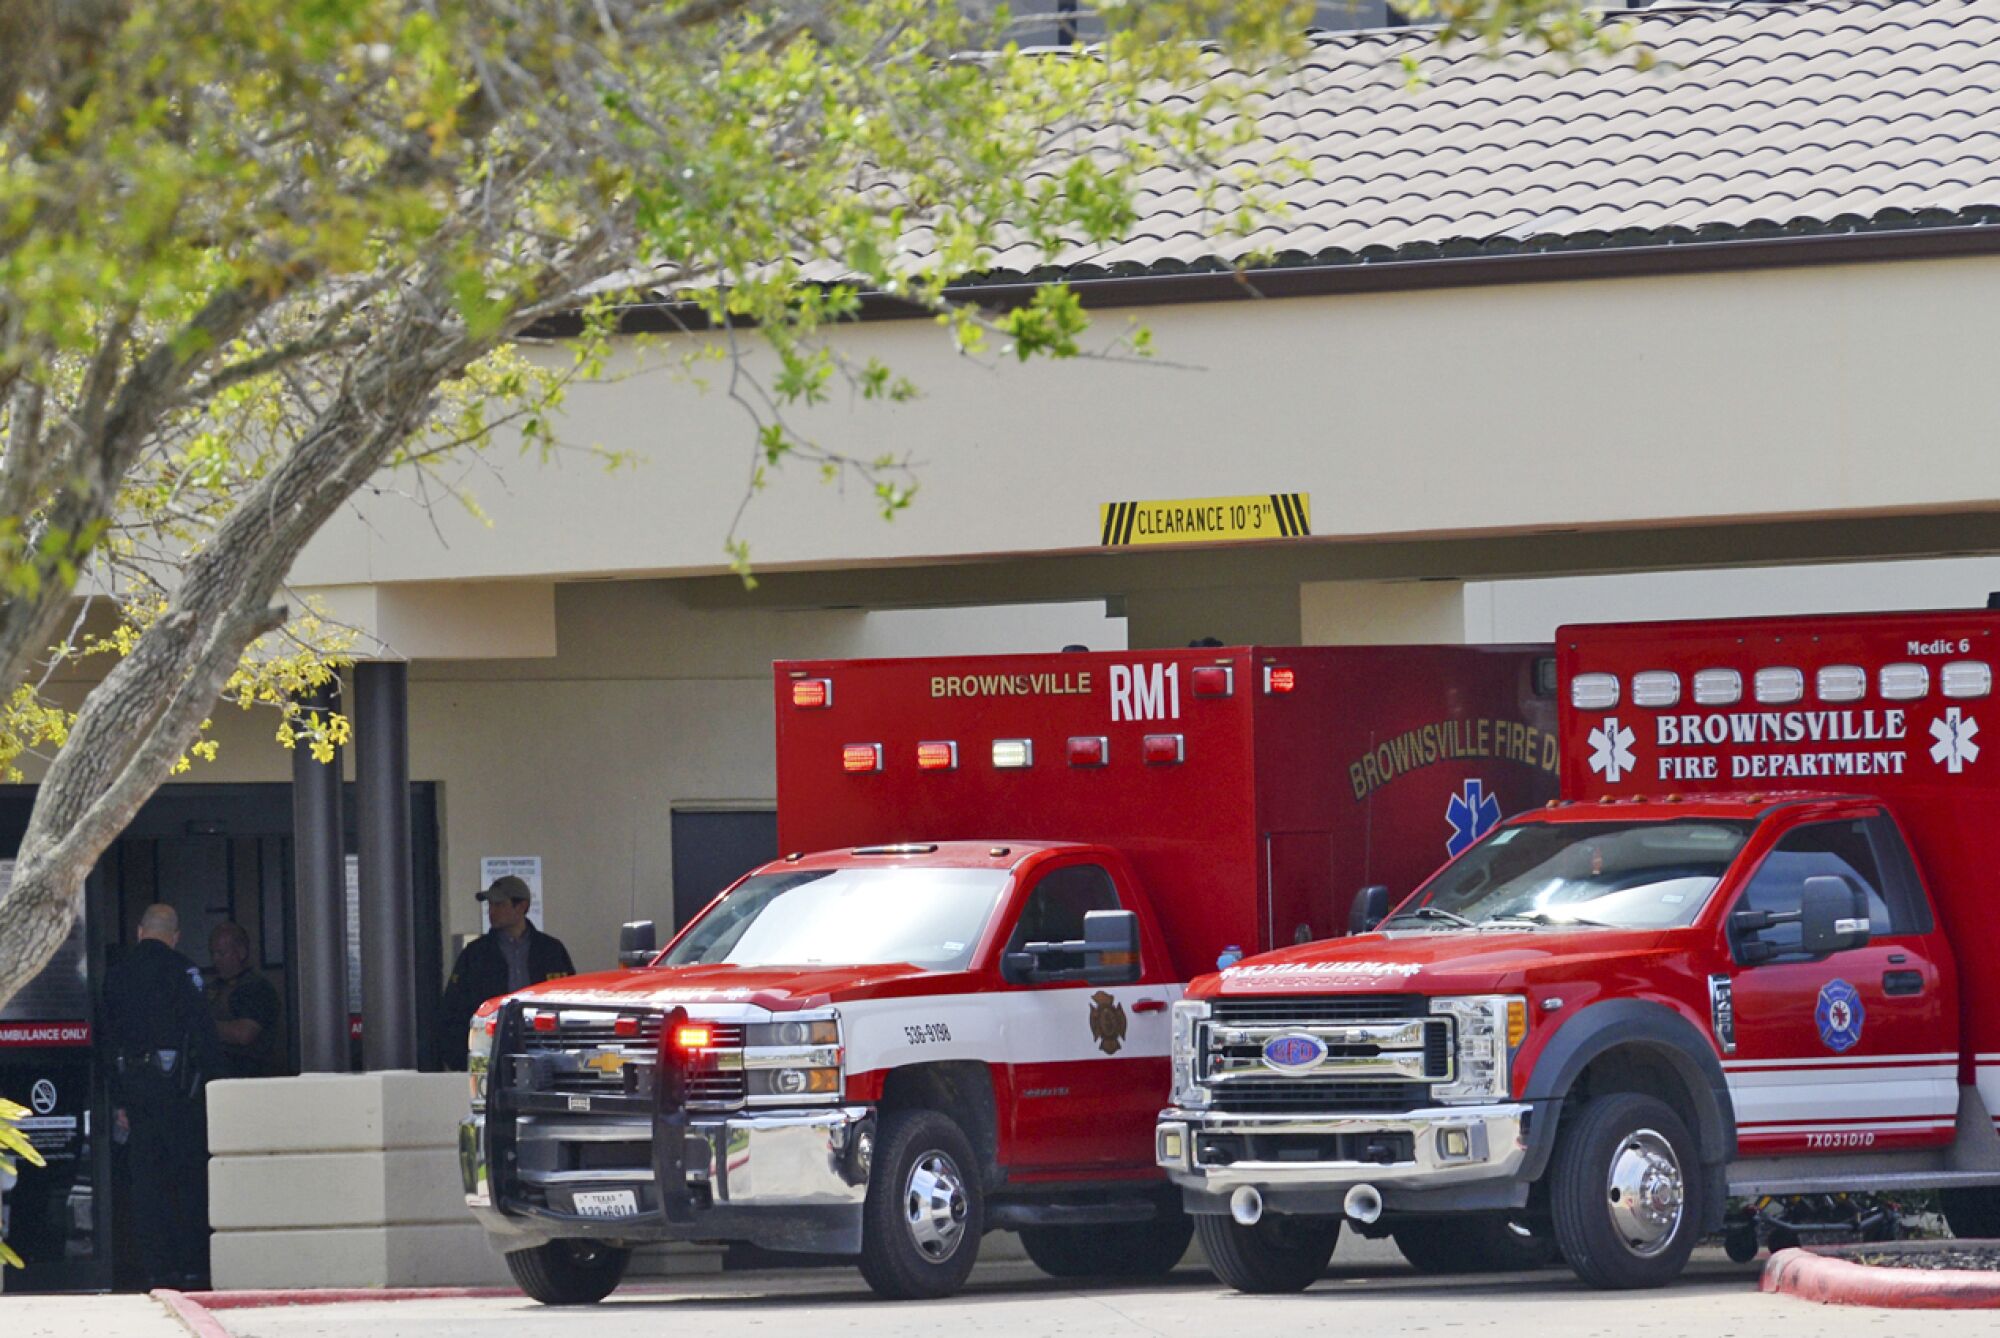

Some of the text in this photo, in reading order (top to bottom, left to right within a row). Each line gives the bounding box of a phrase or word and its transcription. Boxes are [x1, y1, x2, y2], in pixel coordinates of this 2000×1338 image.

[1138, 506, 1225, 535] CLEARANCE
[1907, 639, 1970, 655] Medic 6
[931, 672, 1092, 698] BROWNSVILLE
[1109, 662, 1180, 722] RM1
[1656, 709, 1908, 746] BROWNSVILLE
[1350, 719, 1490, 800] BROWNSVILLE
[1495, 719, 1539, 766] FIRE
[1658, 751, 1907, 780] FIRE DEPARTMENT
[61, 1028, 88, 1041] ONLY
